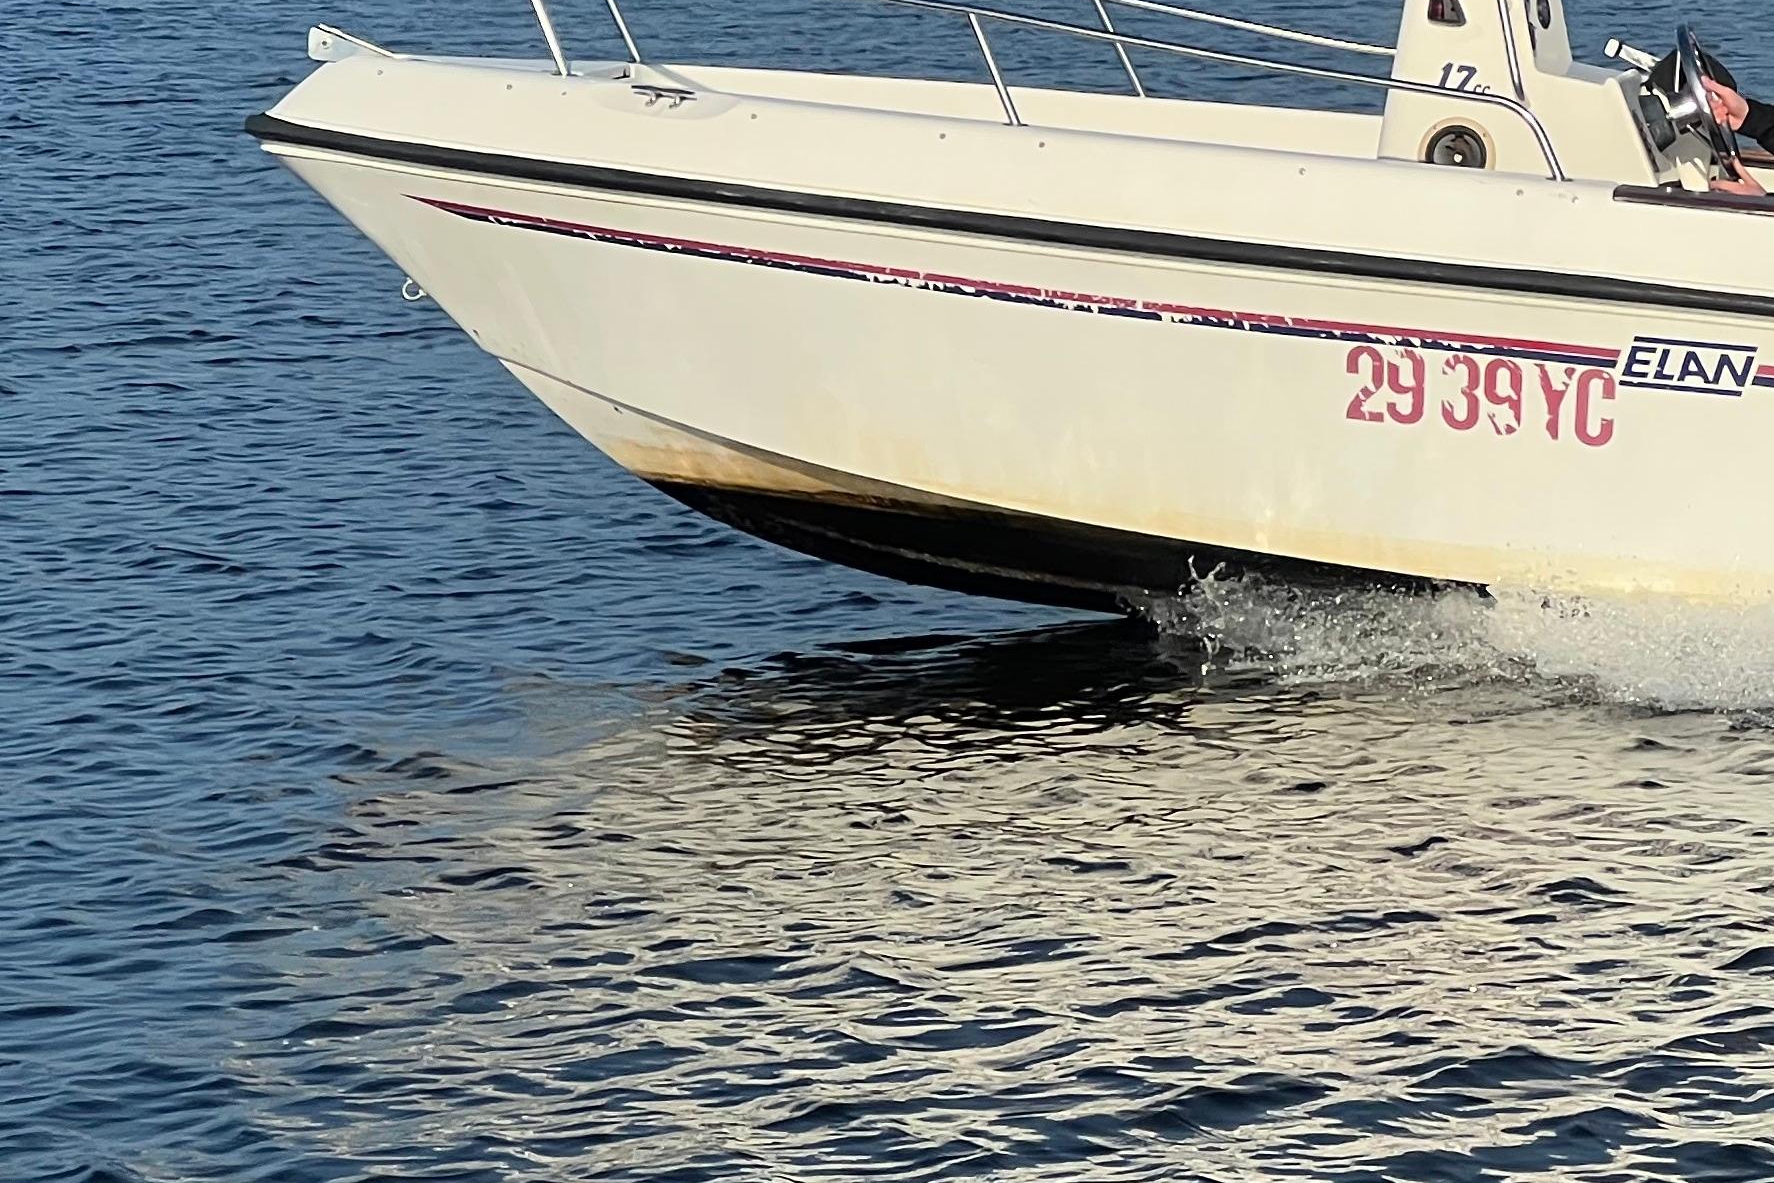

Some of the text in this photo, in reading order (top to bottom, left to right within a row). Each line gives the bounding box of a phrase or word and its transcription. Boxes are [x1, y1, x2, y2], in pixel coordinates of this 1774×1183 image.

[1346, 345, 1425, 424] 29
[1533, 363, 1616, 447] YC
[1622, 346, 1755, 387] ELAN
